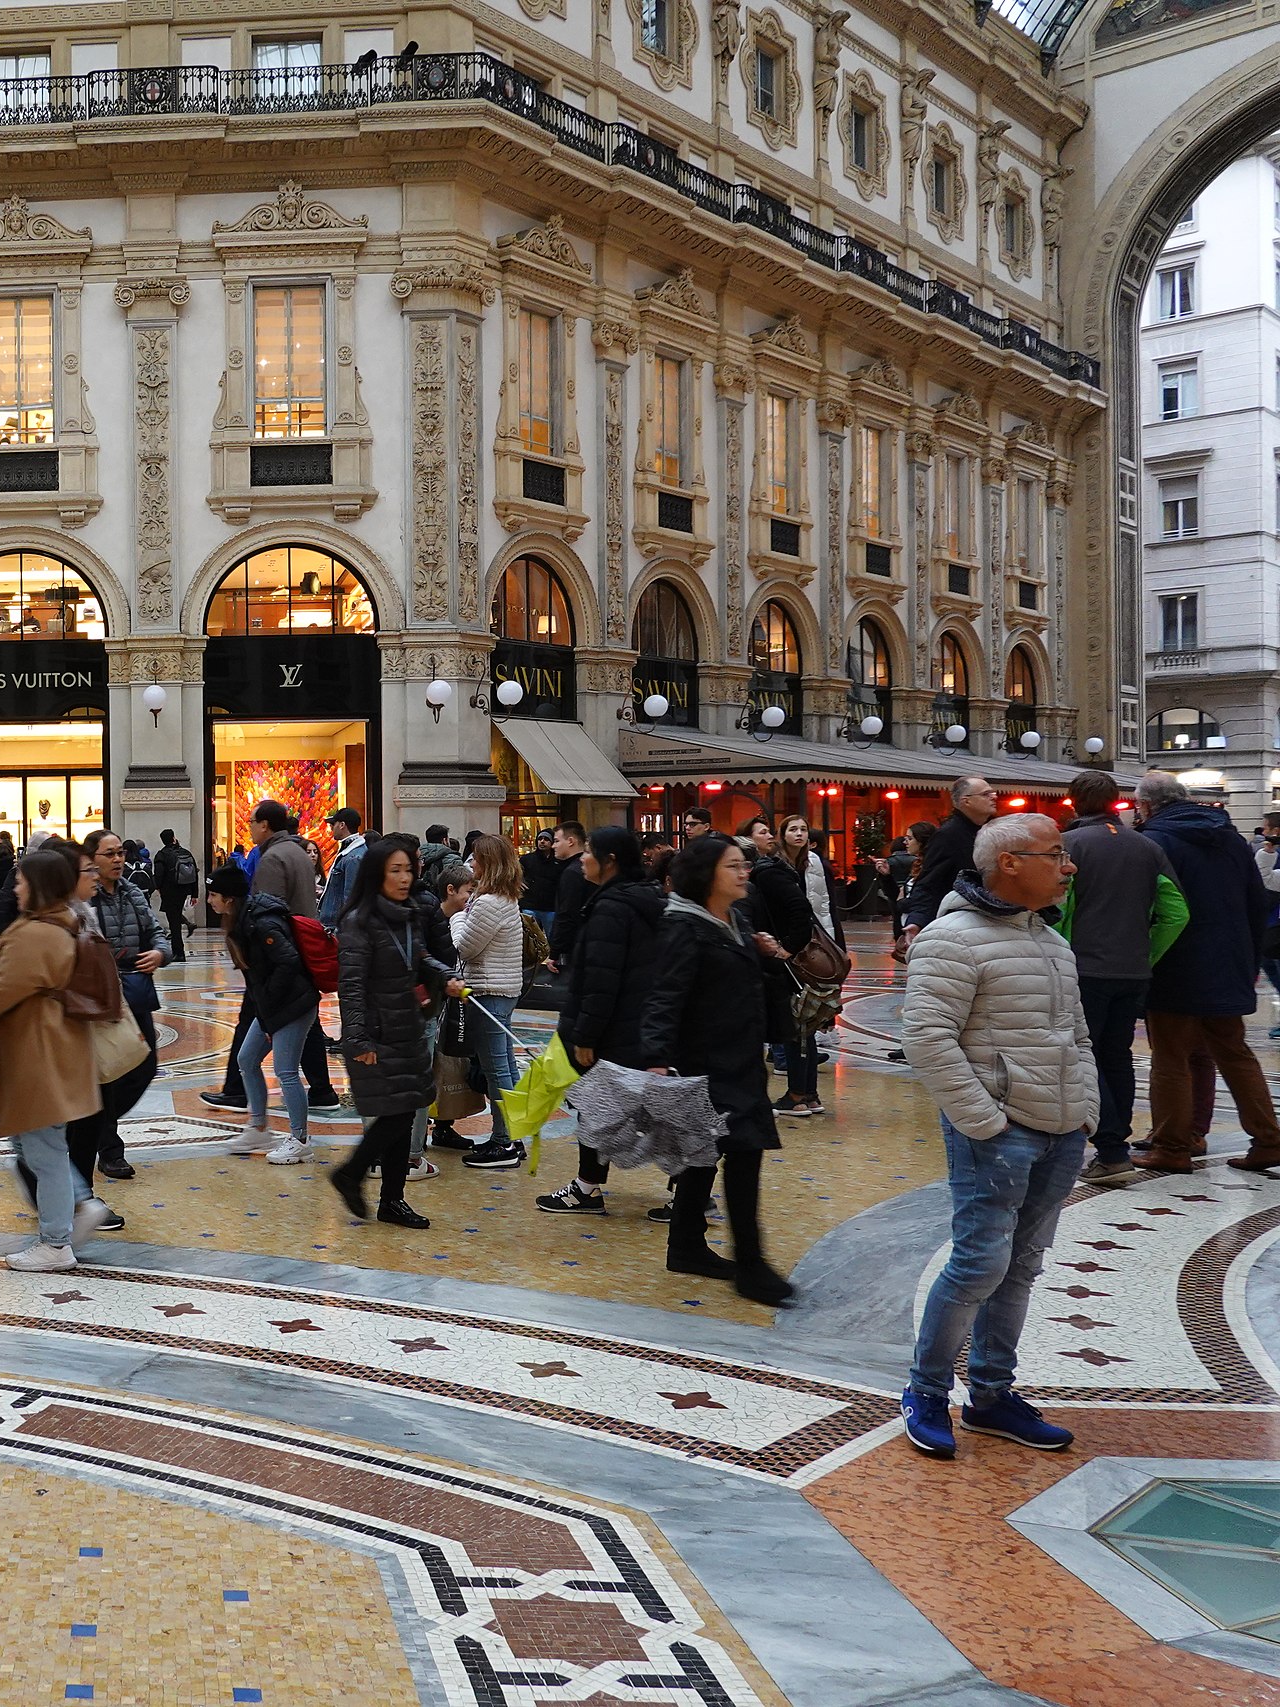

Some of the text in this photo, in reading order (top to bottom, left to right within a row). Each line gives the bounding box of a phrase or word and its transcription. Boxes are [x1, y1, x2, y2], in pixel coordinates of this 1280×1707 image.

[11, 671, 92, 689] VUITTON
[496, 663, 562, 698] SAVINI
[632, 677, 688, 708] SAVINI
